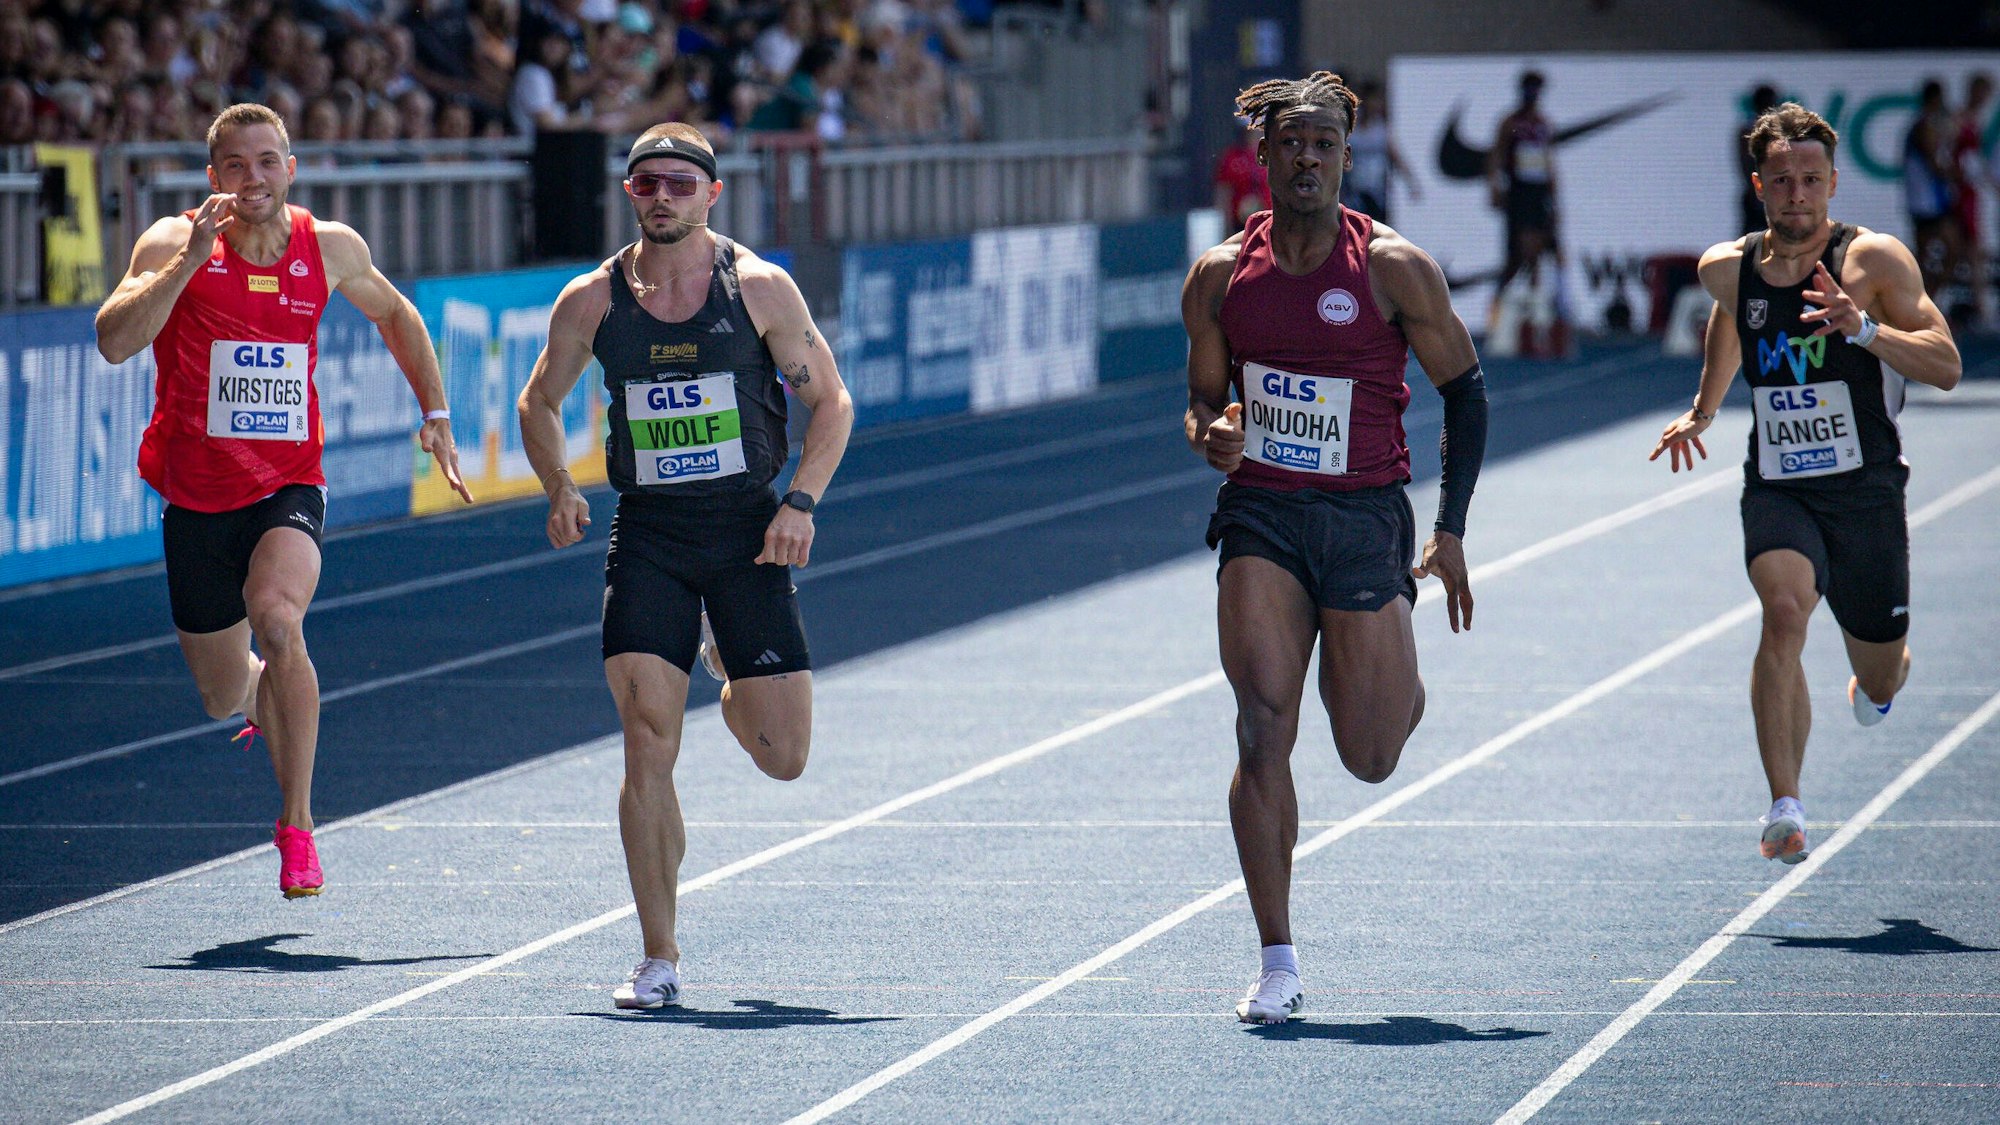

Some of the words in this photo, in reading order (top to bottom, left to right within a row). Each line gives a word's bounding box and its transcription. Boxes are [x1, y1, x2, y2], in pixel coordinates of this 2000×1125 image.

[257, 279, 278, 287] LOTTO
[290, 298, 316, 309] Sparkasse
[1324, 303, 1352, 312] ASV
[290, 307, 314, 316] Neuwied
[218, 375, 302, 406] KIRSTGES
[256, 414, 287, 426] PLAN
[1251, 399, 1341, 442] ONUOHA
[646, 415, 721, 449] WOLF
[1765, 413, 1848, 446] LANGE
[1282, 446, 1318, 462] PLAN
[1330, 451, 1341, 467] 665
[1800, 451, 1834, 463] PLAN
[681, 454, 717, 468] PLAN
[1282, 457, 1317, 467] INTERNATIONAL
[682, 465, 718, 473] INTERNATIONAL
